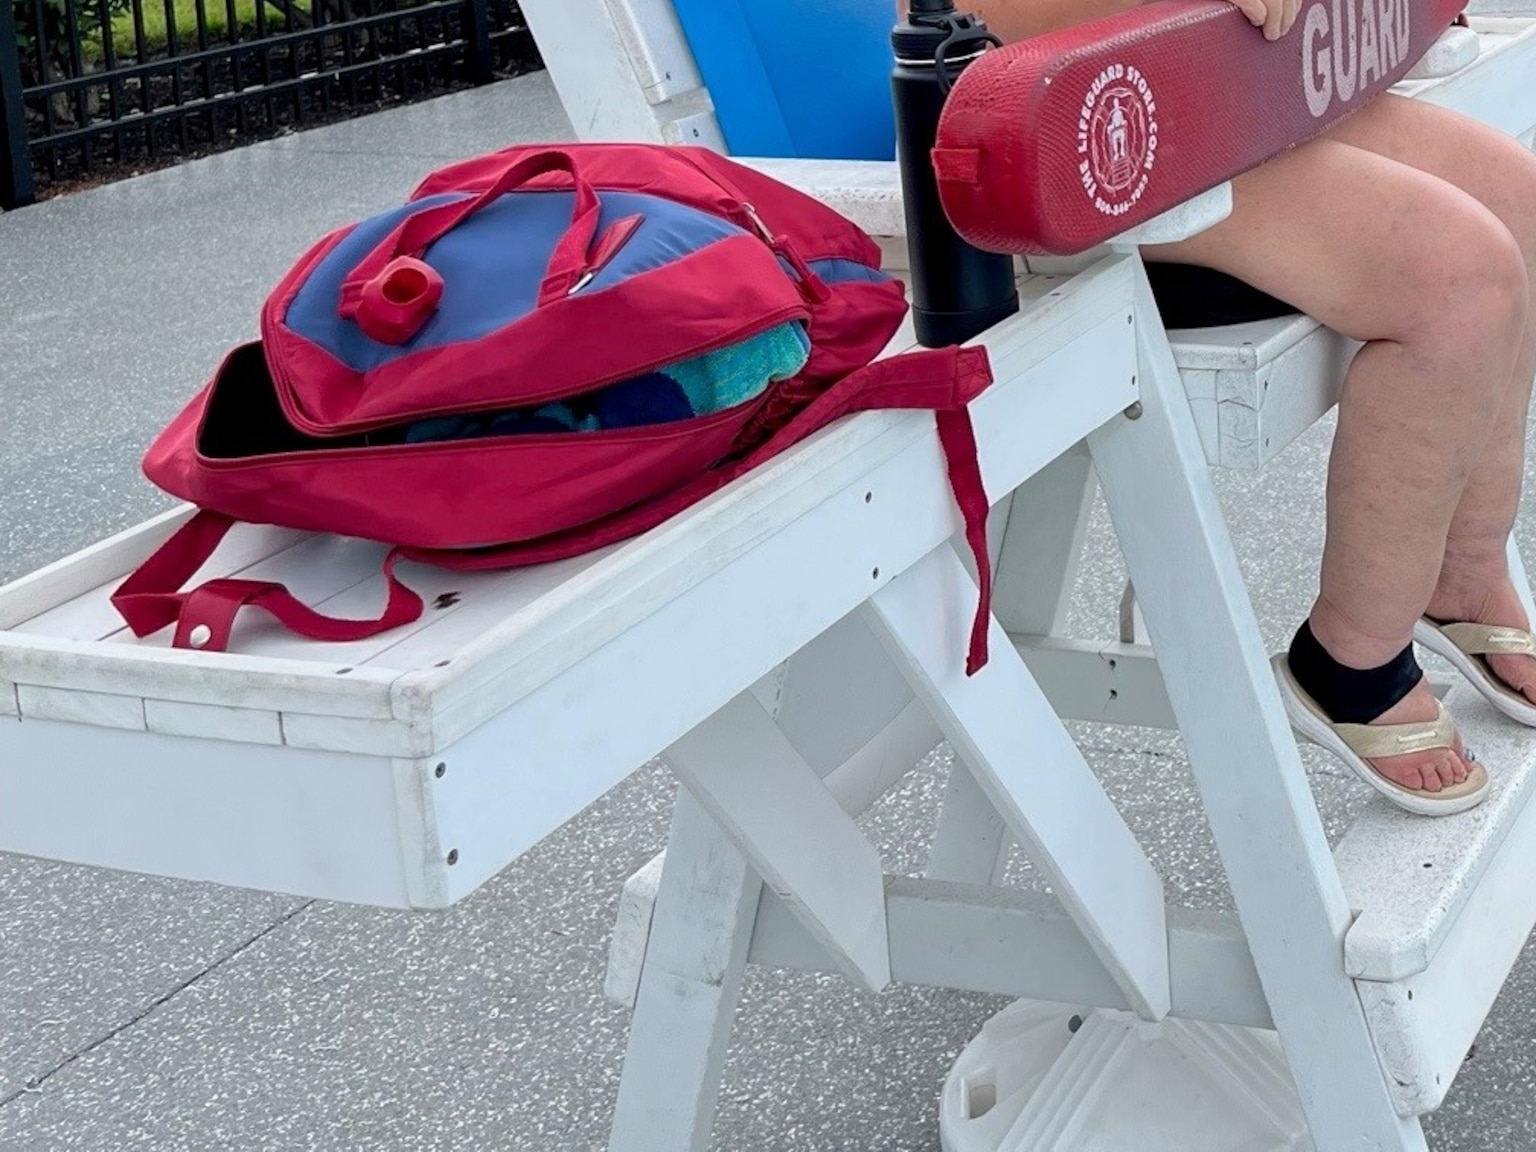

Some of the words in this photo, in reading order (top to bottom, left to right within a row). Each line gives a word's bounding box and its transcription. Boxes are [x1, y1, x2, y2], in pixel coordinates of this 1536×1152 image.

[1077, 63, 1123, 153] LIFEGUARD
[1126, 66, 1158, 170] STORE.COM
[1079, 159, 1097, 199] THE
